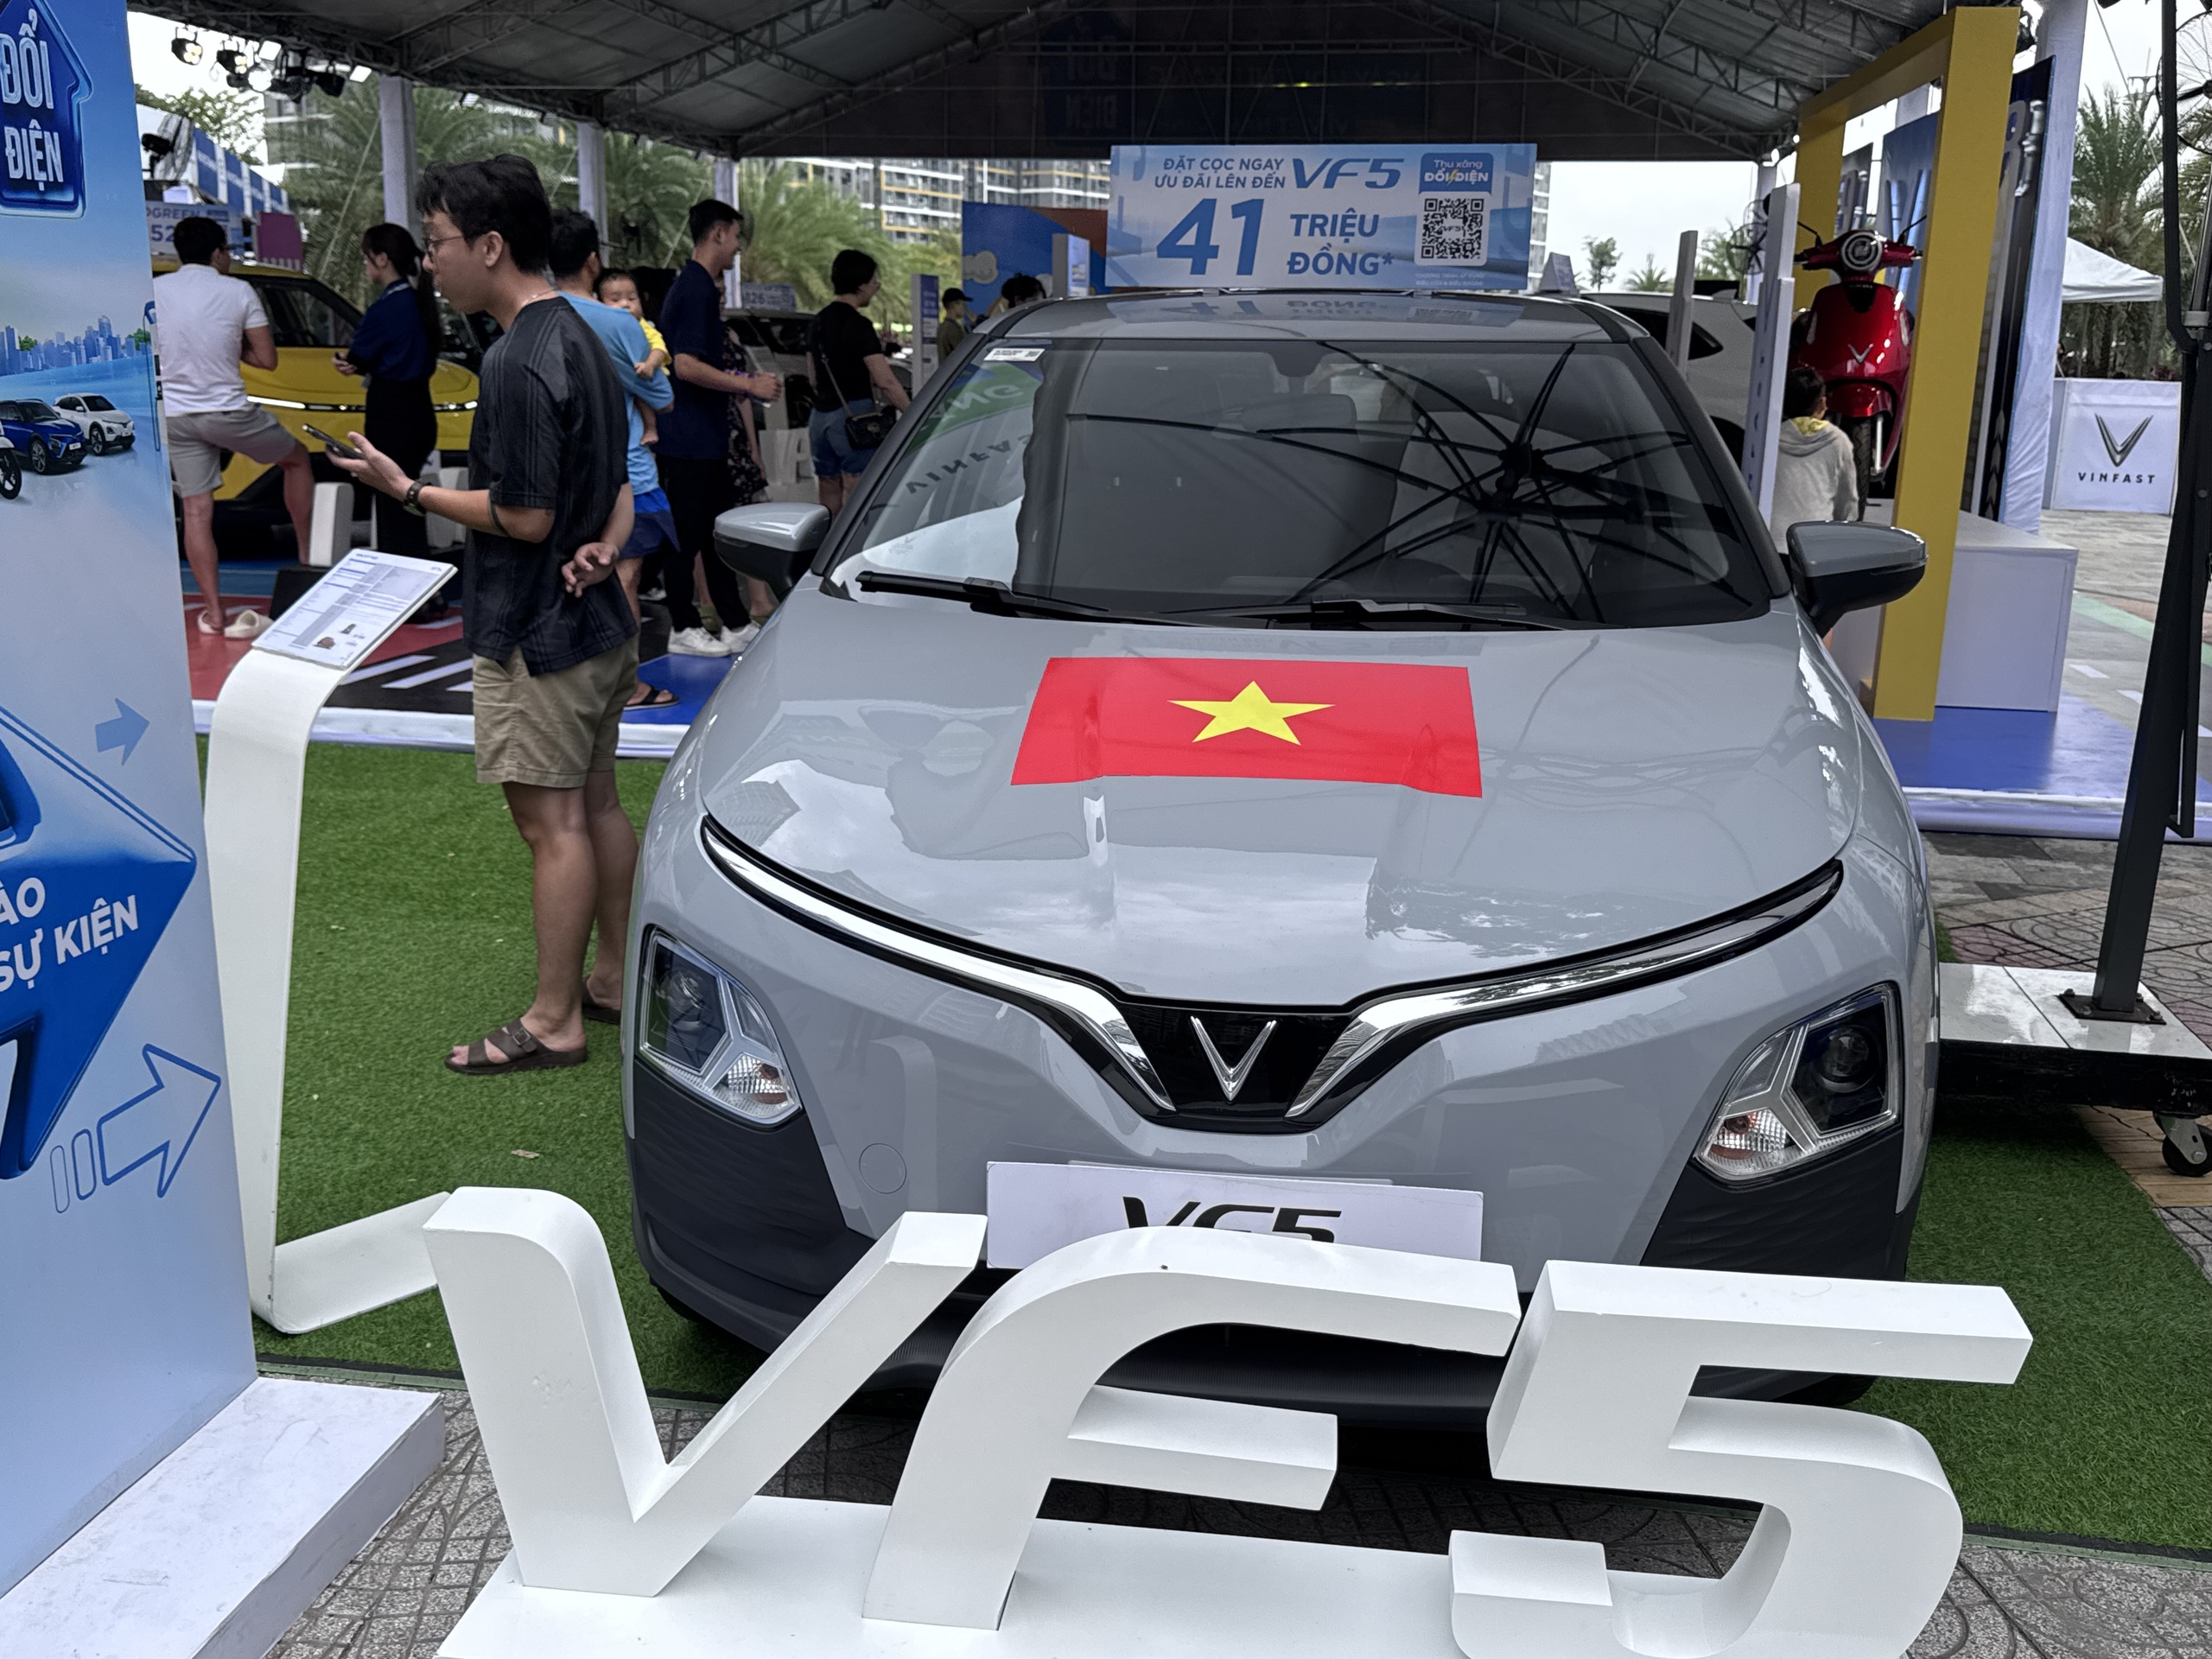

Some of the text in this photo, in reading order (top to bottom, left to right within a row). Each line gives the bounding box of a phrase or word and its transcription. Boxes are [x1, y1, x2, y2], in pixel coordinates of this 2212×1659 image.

[0, 8, 54, 110] ĐỔI
[3, 118, 64, 191] ĐIỆN
[1154, 171, 1286, 189] ƯU ĐÃI LÊN ĐẾN
[1163, 155, 1285, 173] ĐẶT CỌC NGAY
[1293, 157, 1405, 189] VF5
[1156, 198, 1265, 276] 41
[1289, 207, 1380, 244] TRIỆU
[2077, 472, 2156, 484] VINFAST
[54, 893, 139, 966] KIỆN
[425, 1185, 2034, 1658] VF5
